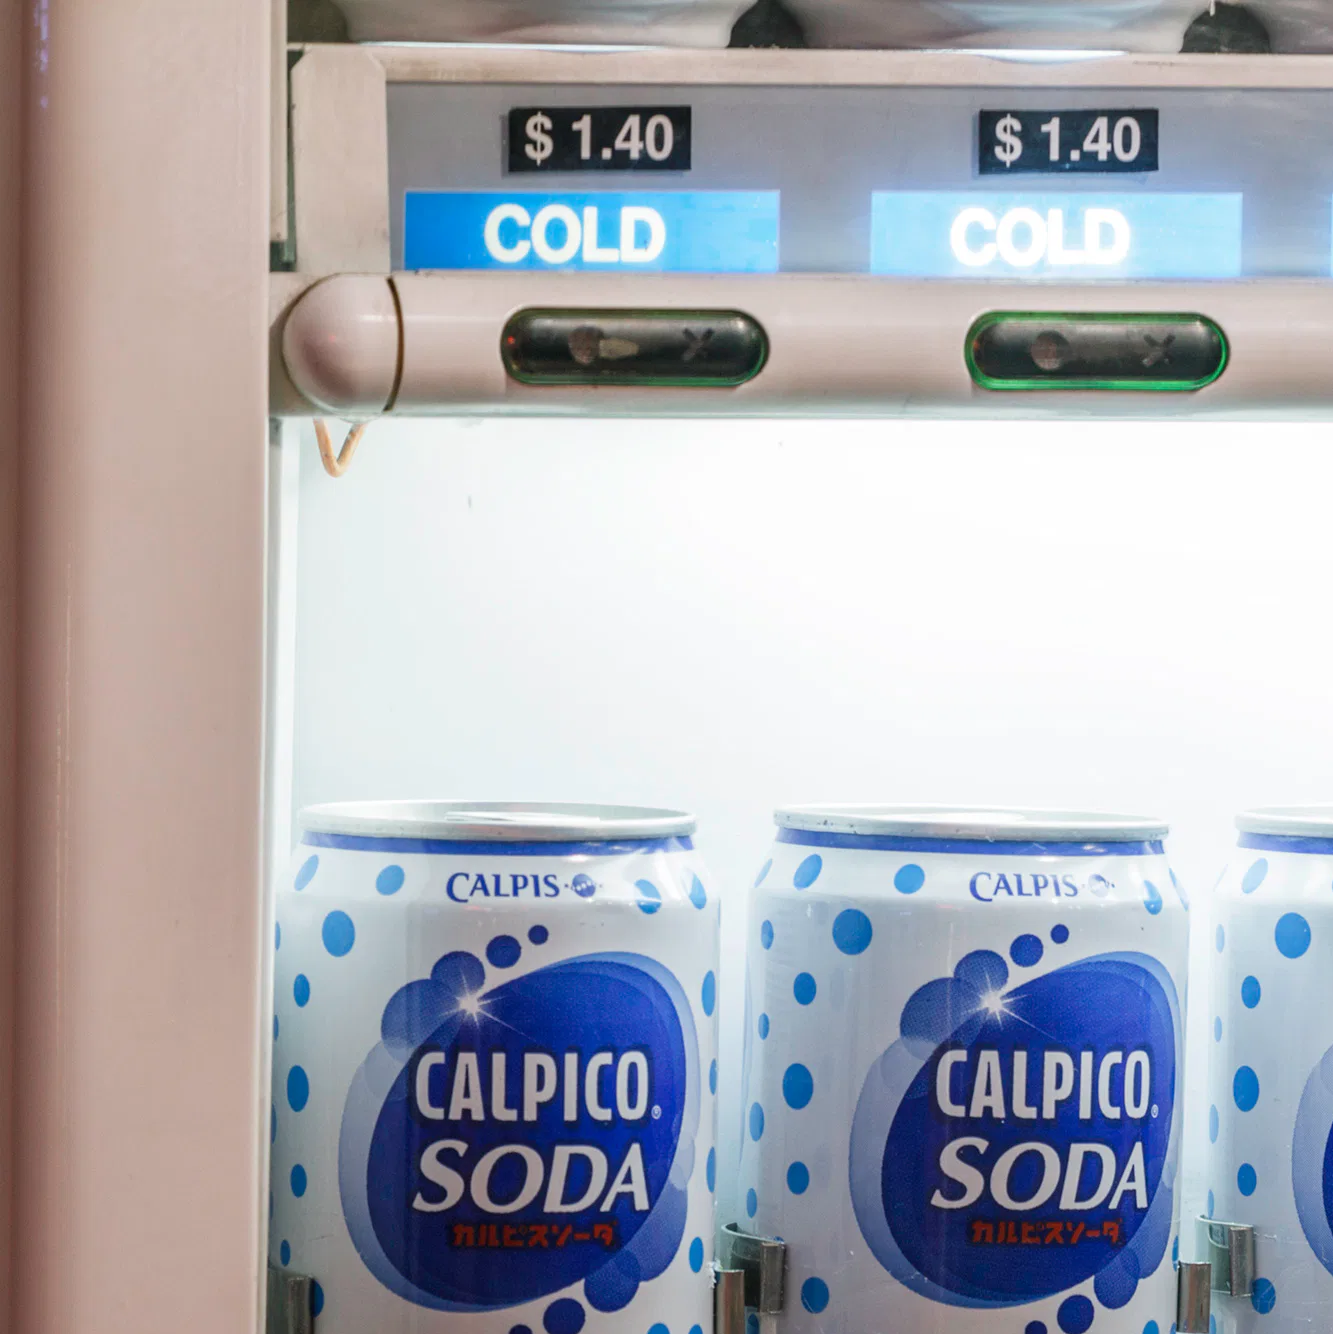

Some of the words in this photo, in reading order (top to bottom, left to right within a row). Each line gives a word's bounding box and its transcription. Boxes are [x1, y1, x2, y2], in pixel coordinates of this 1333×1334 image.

[525, 112, 554, 166] $
[571, 114, 674, 162] 1.40
[994, 114, 1023, 166] $
[1041, 117, 1142, 163] 1.40
[484, 204, 666, 264] COLD
[950, 209, 1130, 267] COLD
[446, 872, 560, 903] CALPIS
[969, 871, 1079, 902] CALPIS
[415, 1050, 650, 1122] CALPICO
[936, 1049, 1151, 1120] CALPICO
[411, 1138, 650, 1214] SODA
[930, 1136, 1150, 1211] SODA
[452, 1220, 618, 1248] カルピスソーダ
[971, 1217, 1123, 1245] カルピスソーダ
